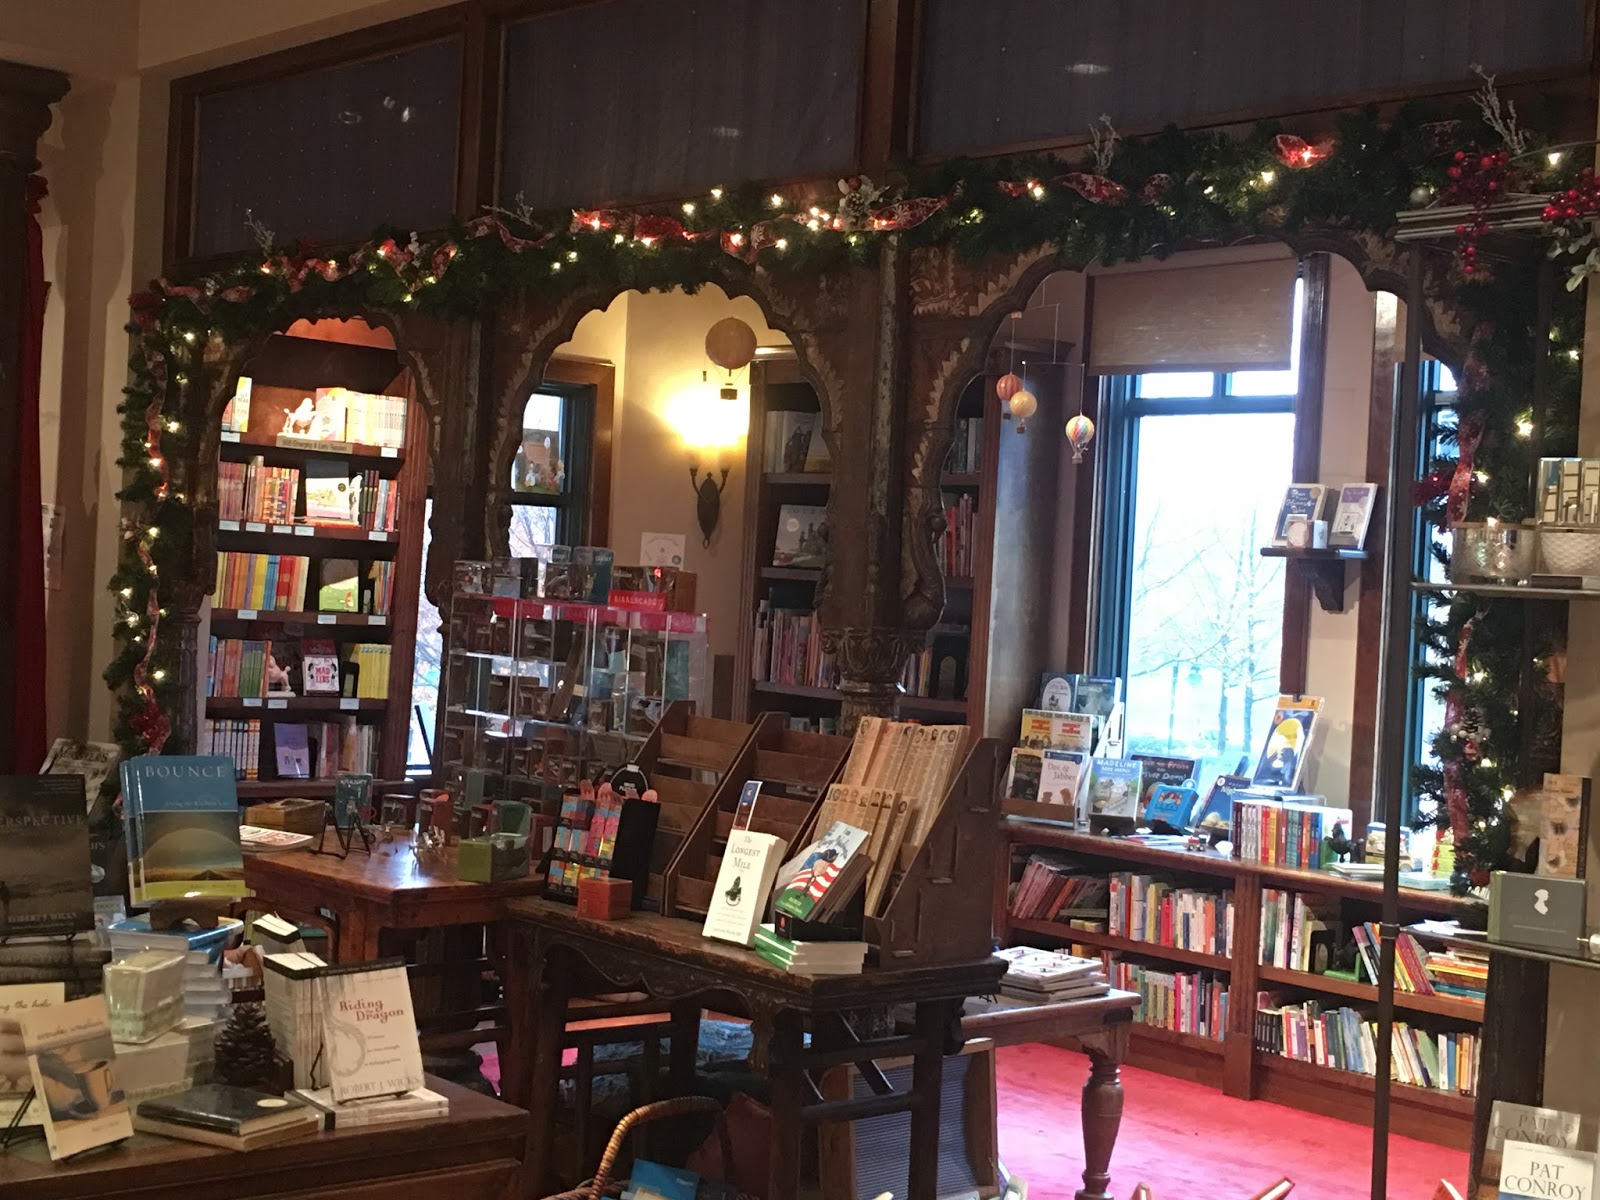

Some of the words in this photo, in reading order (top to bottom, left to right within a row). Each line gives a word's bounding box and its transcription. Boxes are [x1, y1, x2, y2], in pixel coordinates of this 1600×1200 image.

[315, 667, 331, 675] MAD
[315, 675, 330, 683] LIBS
[1097, 759, 1137, 769] MADELINE
[145, 765, 226, 778] BOUNCE
[731, 843, 760, 857] LONGEST
[339, 999, 384, 1013] Riding
[356, 1008, 404, 1023] Dragon
[340, 1081, 376, 1097] ROBERT
[386, 1076, 421, 1090] WICKS
[1519, 1114, 1548, 1131] PAT
[1492, 1125, 1568, 1149] CONROY
[1530, 1161, 1565, 1180] PAT
[1504, 1174, 1587, 1200] CONROY
